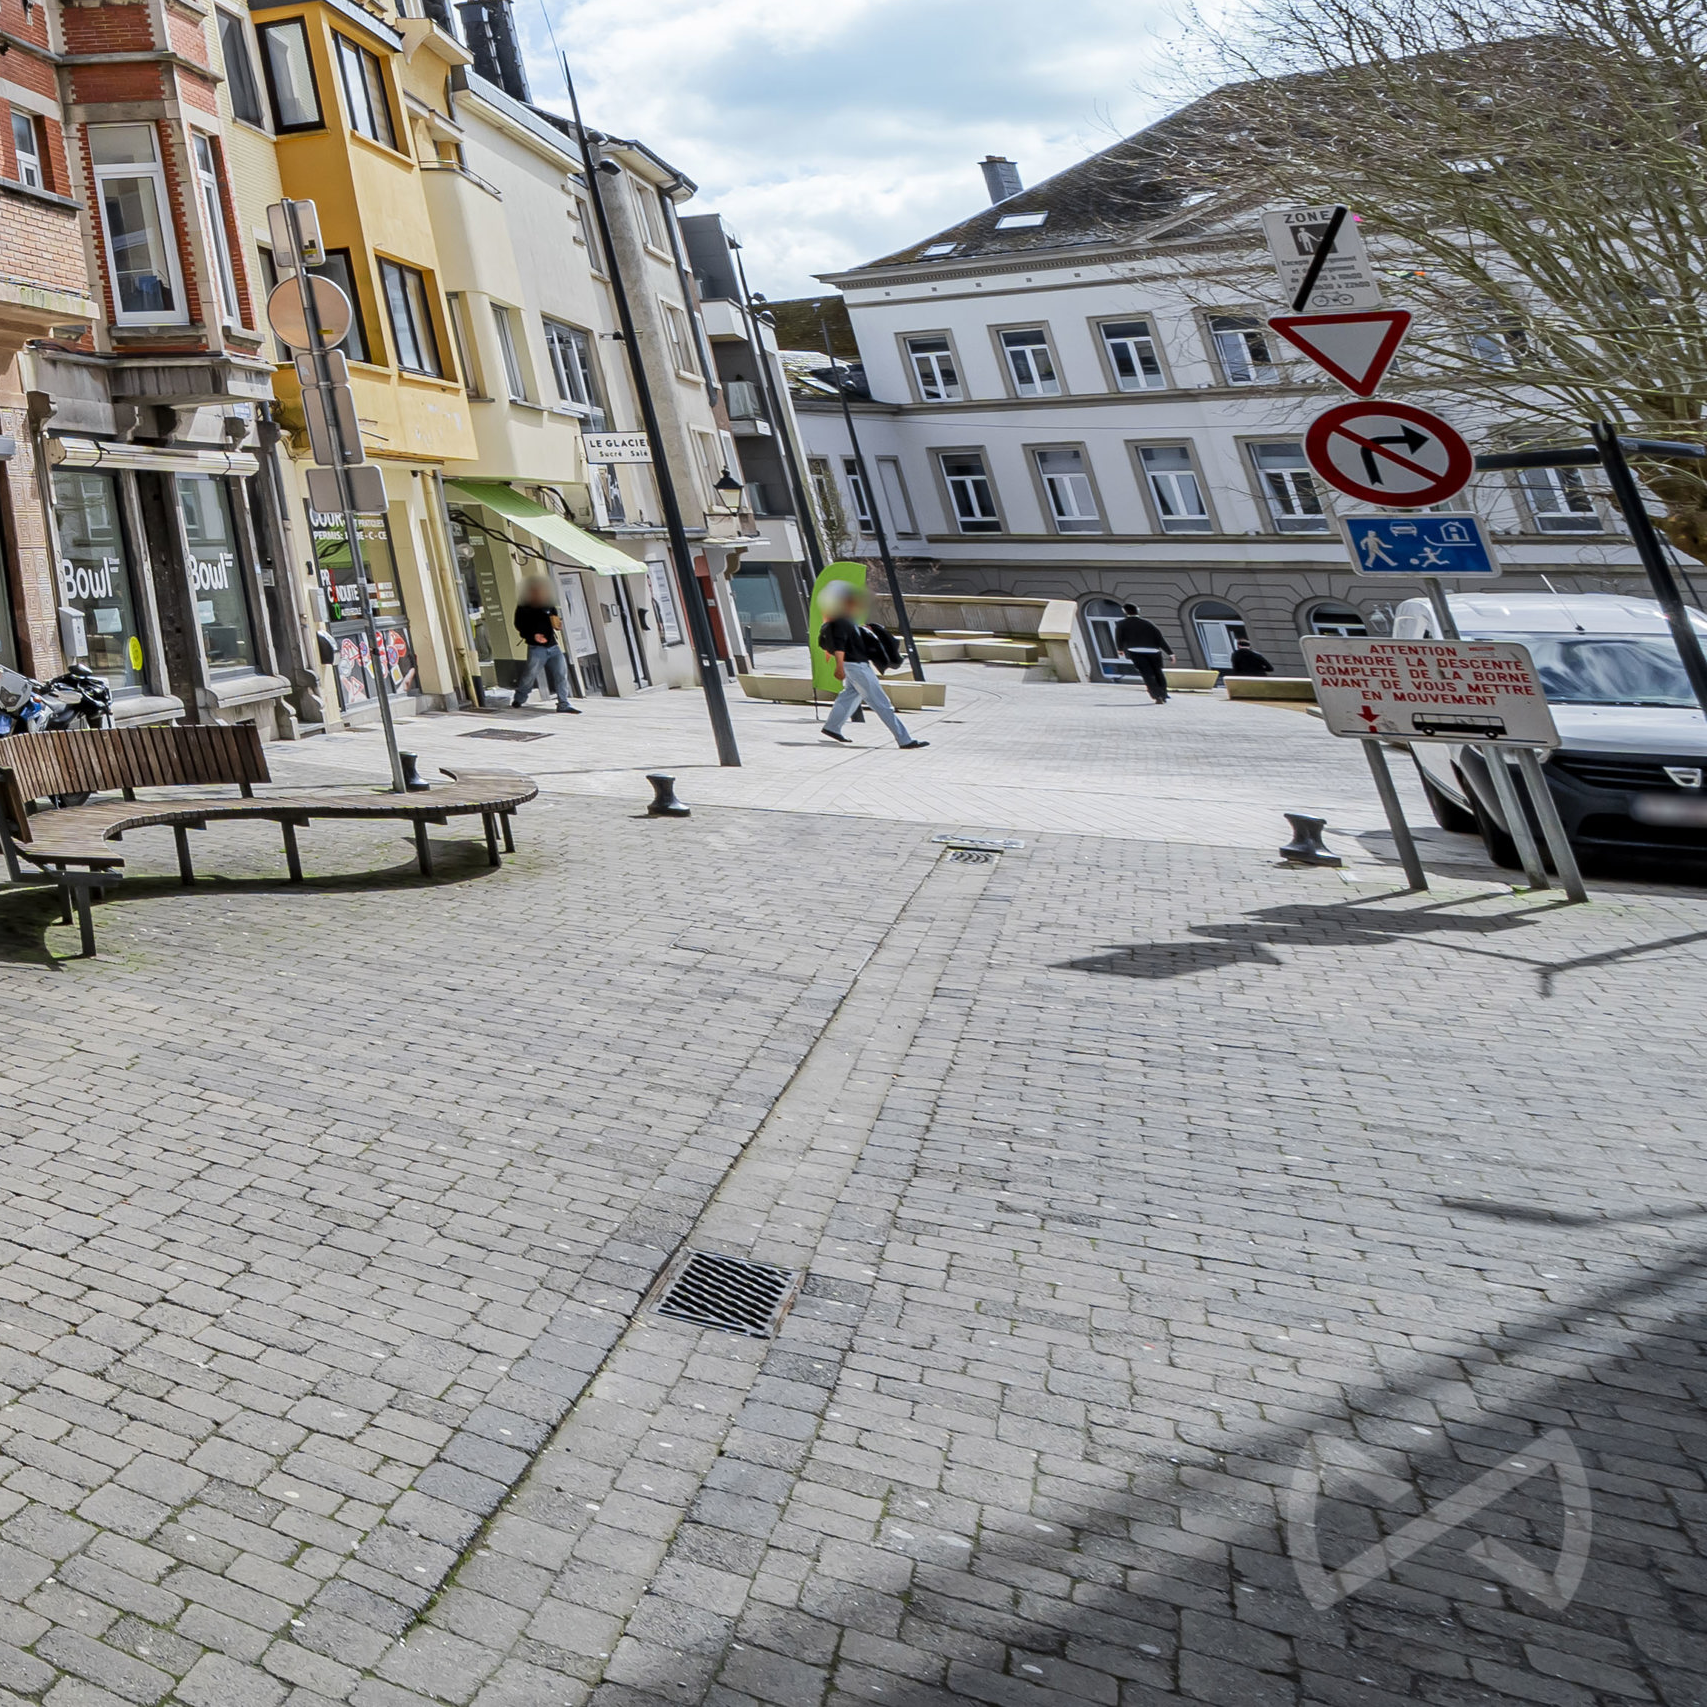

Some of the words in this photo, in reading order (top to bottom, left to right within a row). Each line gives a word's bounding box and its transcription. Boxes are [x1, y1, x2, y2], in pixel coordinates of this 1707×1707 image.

[1283, 210, 1331, 224] ZONE
[589, 439, 603, 448] LE
[605, 438, 648, 448] GLACIE
[599, 450, 622, 458] Sucré
[62, 556, 113, 600] Bowl
[188, 552, 229, 591] Bowl
[1369, 644, 1457, 657] ATTENTION
[1315, 654, 1396, 667] ATTENDRE
[1406, 657, 1427, 668] LA
[1437, 658, 1525, 671] DESCENTE
[1315, 665, 1400, 678] COMPLETE
[1409, 669, 1430, 680] DE
[1441, 670, 1462, 681] LA
[1473, 671, 1532, 684] BORNE
[1320, 677, 1370, 689] AVANT
[1381, 679, 1402, 690] DE
[1413, 681, 1457, 692] VOUS
[1467, 683, 1536, 696] METTRE
[1361, 690, 1383, 701] EN
[1393, 693, 1497, 706] MOUVEMENT
